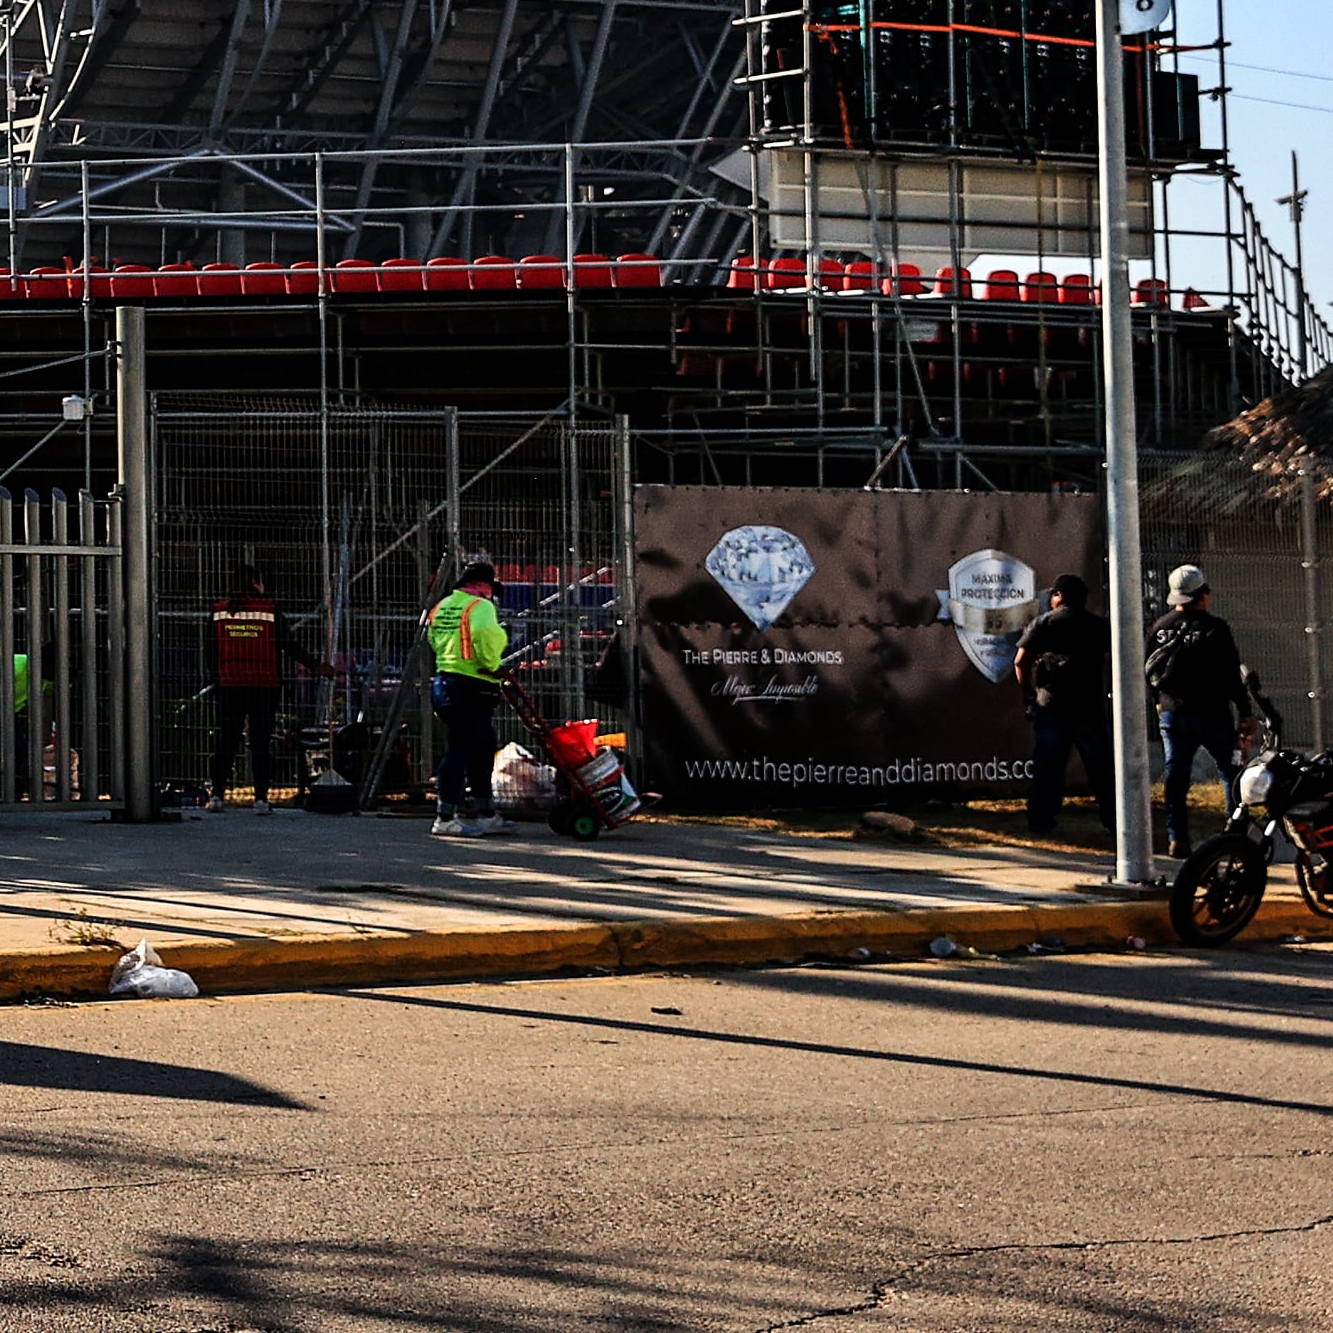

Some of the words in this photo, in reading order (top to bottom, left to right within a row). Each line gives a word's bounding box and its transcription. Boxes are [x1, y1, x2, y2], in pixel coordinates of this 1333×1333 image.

[683, 649, 709, 665] THE
[712, 649, 758, 665] PIERRE
[760, 648, 771, 664] &
[774, 649, 844, 665] DIAMONDS
